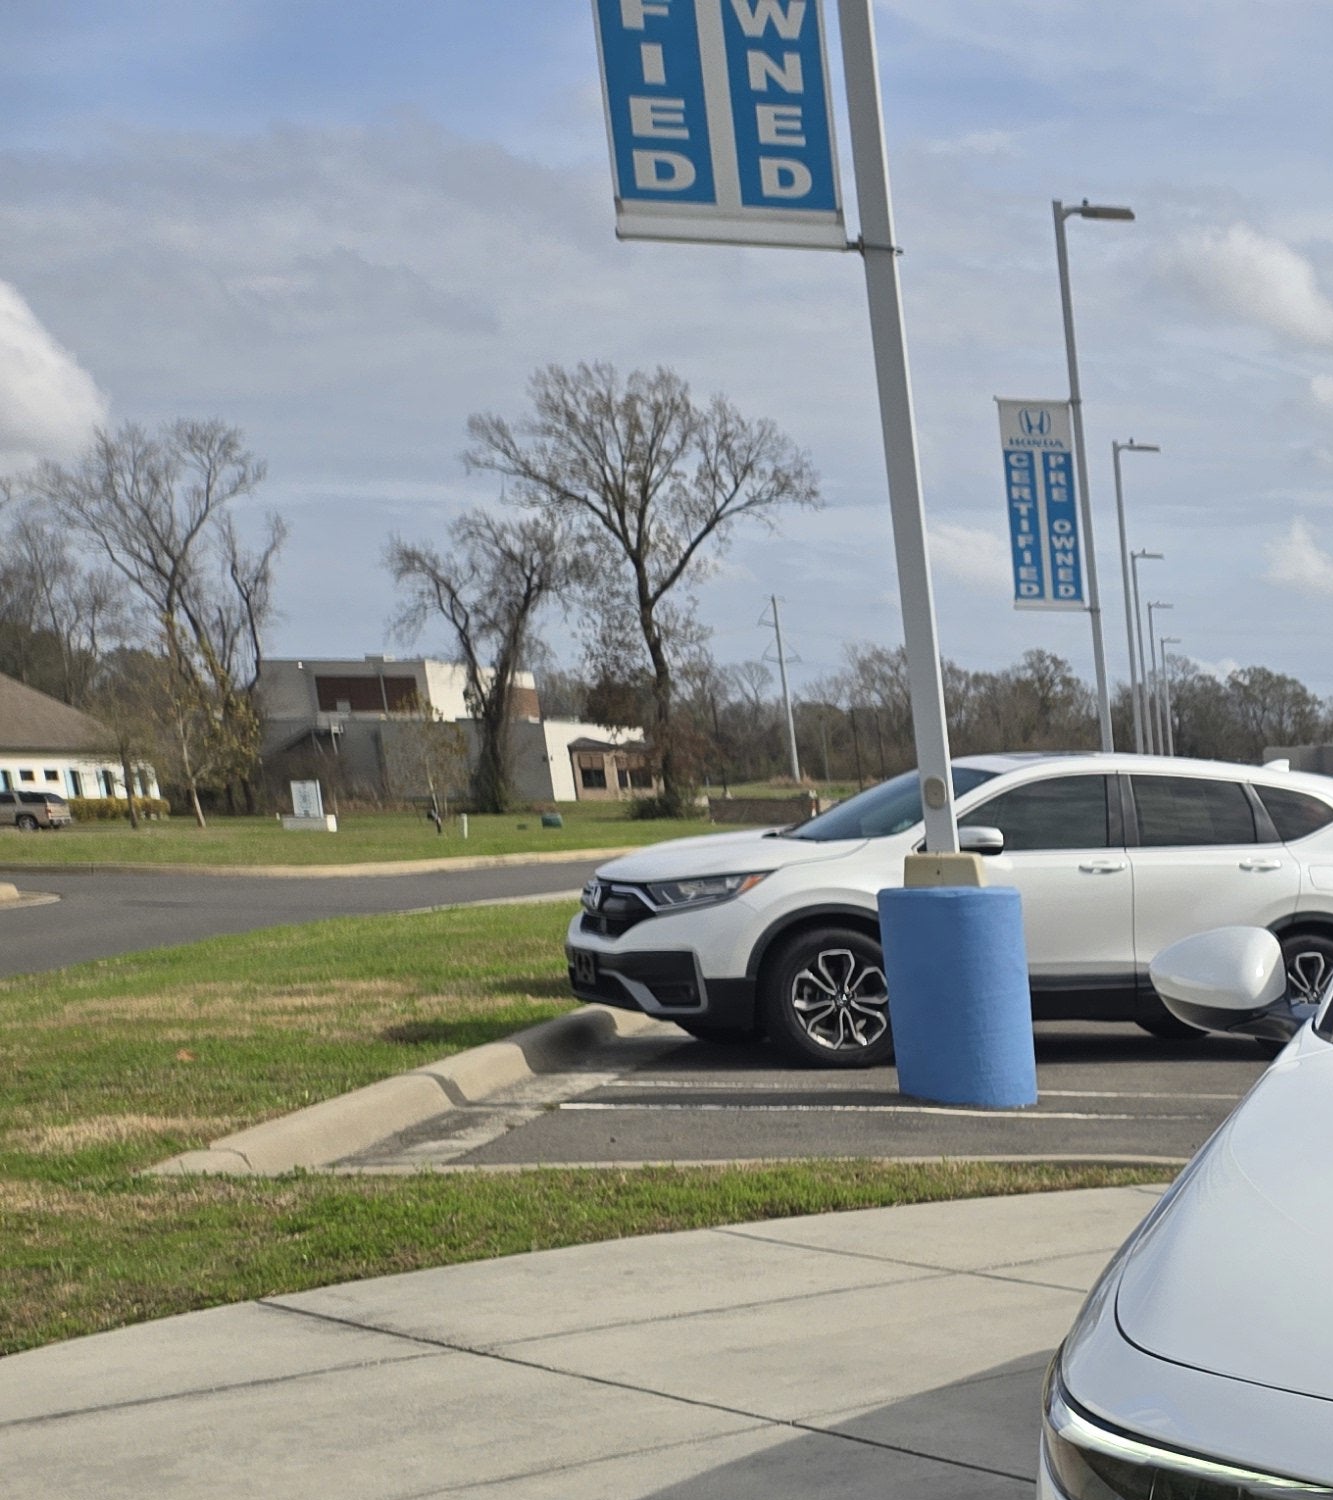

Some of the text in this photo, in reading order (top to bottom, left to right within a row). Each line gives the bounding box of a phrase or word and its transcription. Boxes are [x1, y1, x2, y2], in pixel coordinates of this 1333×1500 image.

[1009, 436, 1064, 448] HONDA
[1009, 453, 1039, 596] CERTIFIED
[1048, 454, 1076, 598] PRE OWNED
